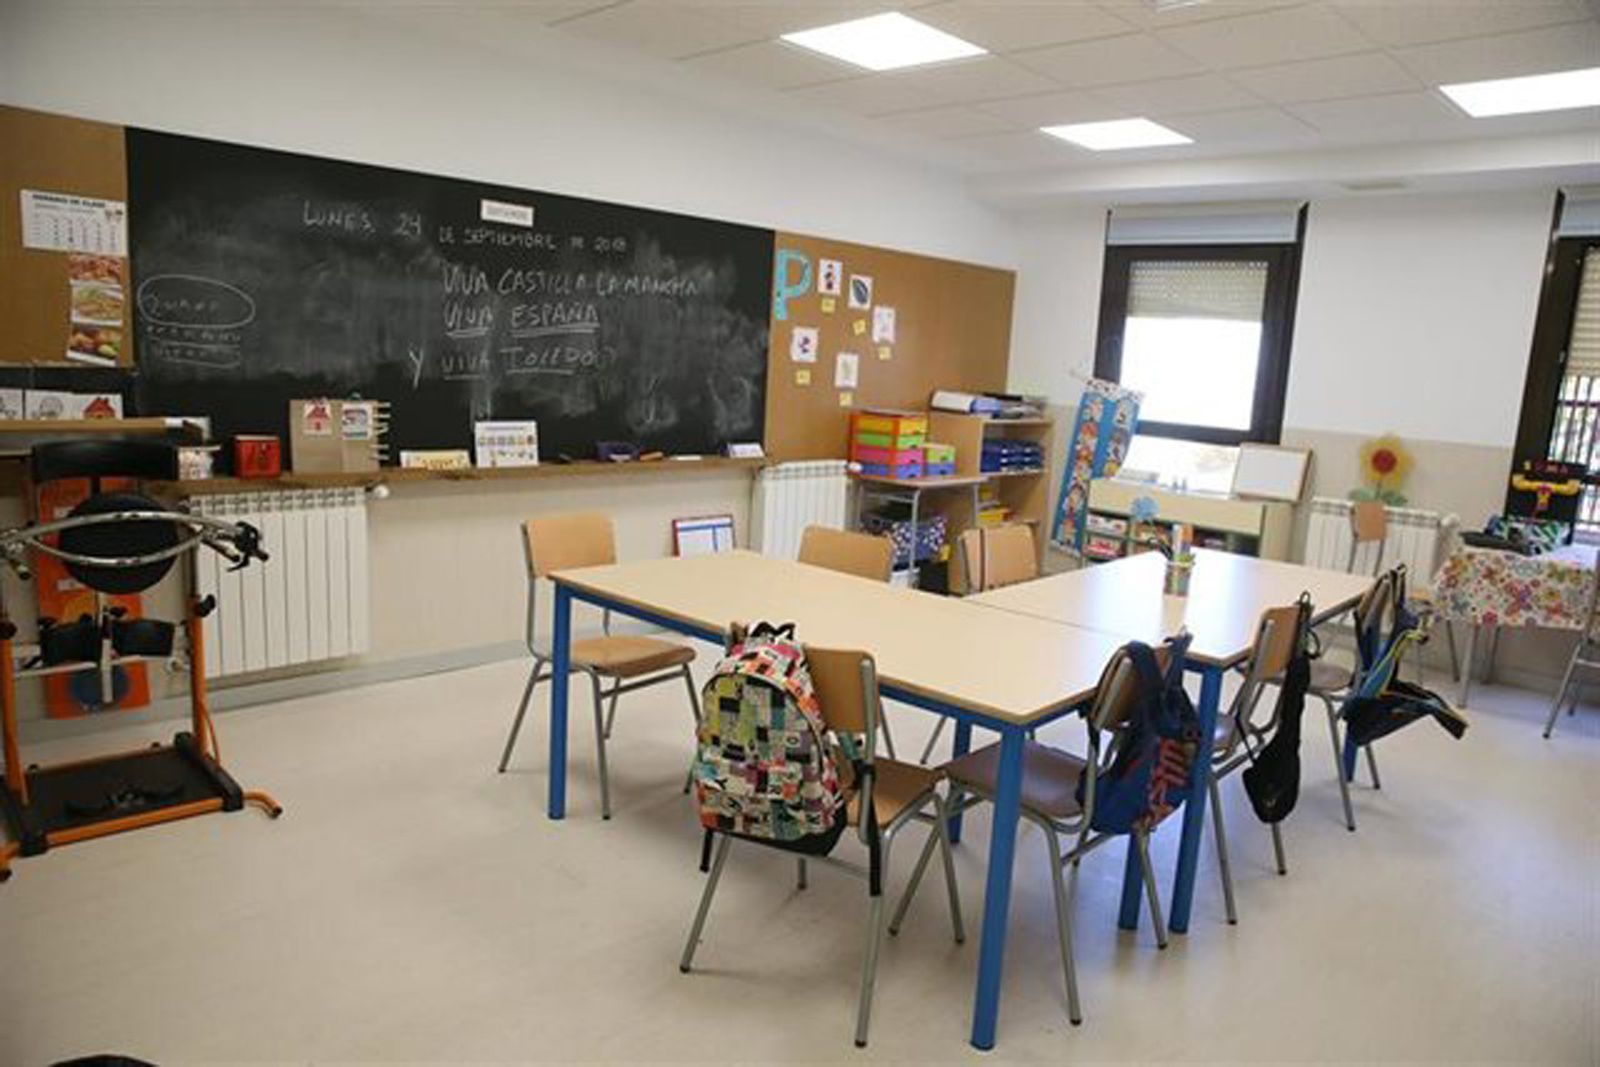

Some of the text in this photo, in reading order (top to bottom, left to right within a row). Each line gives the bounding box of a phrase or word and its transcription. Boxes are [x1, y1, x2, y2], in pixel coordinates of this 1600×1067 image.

[442, 263, 489, 295] VIVA
[444, 302, 599, 329] VIVA ESPAÑA
